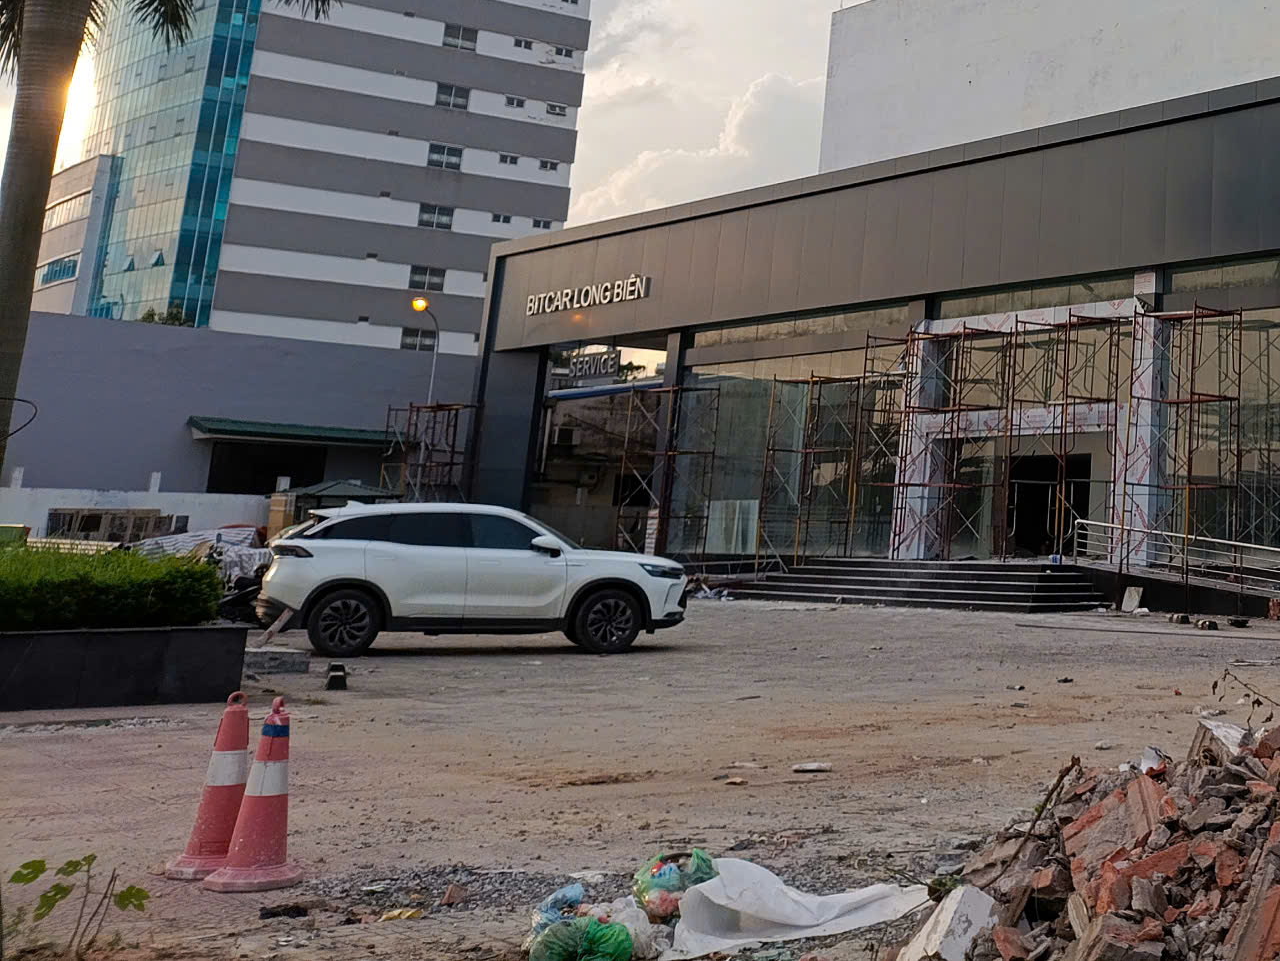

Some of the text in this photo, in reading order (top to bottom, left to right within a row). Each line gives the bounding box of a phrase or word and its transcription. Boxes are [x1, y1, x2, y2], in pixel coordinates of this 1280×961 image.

[526, 273, 648, 316] BITCAR LONG BIÊN
[568, 353, 618, 378] SERVICE
